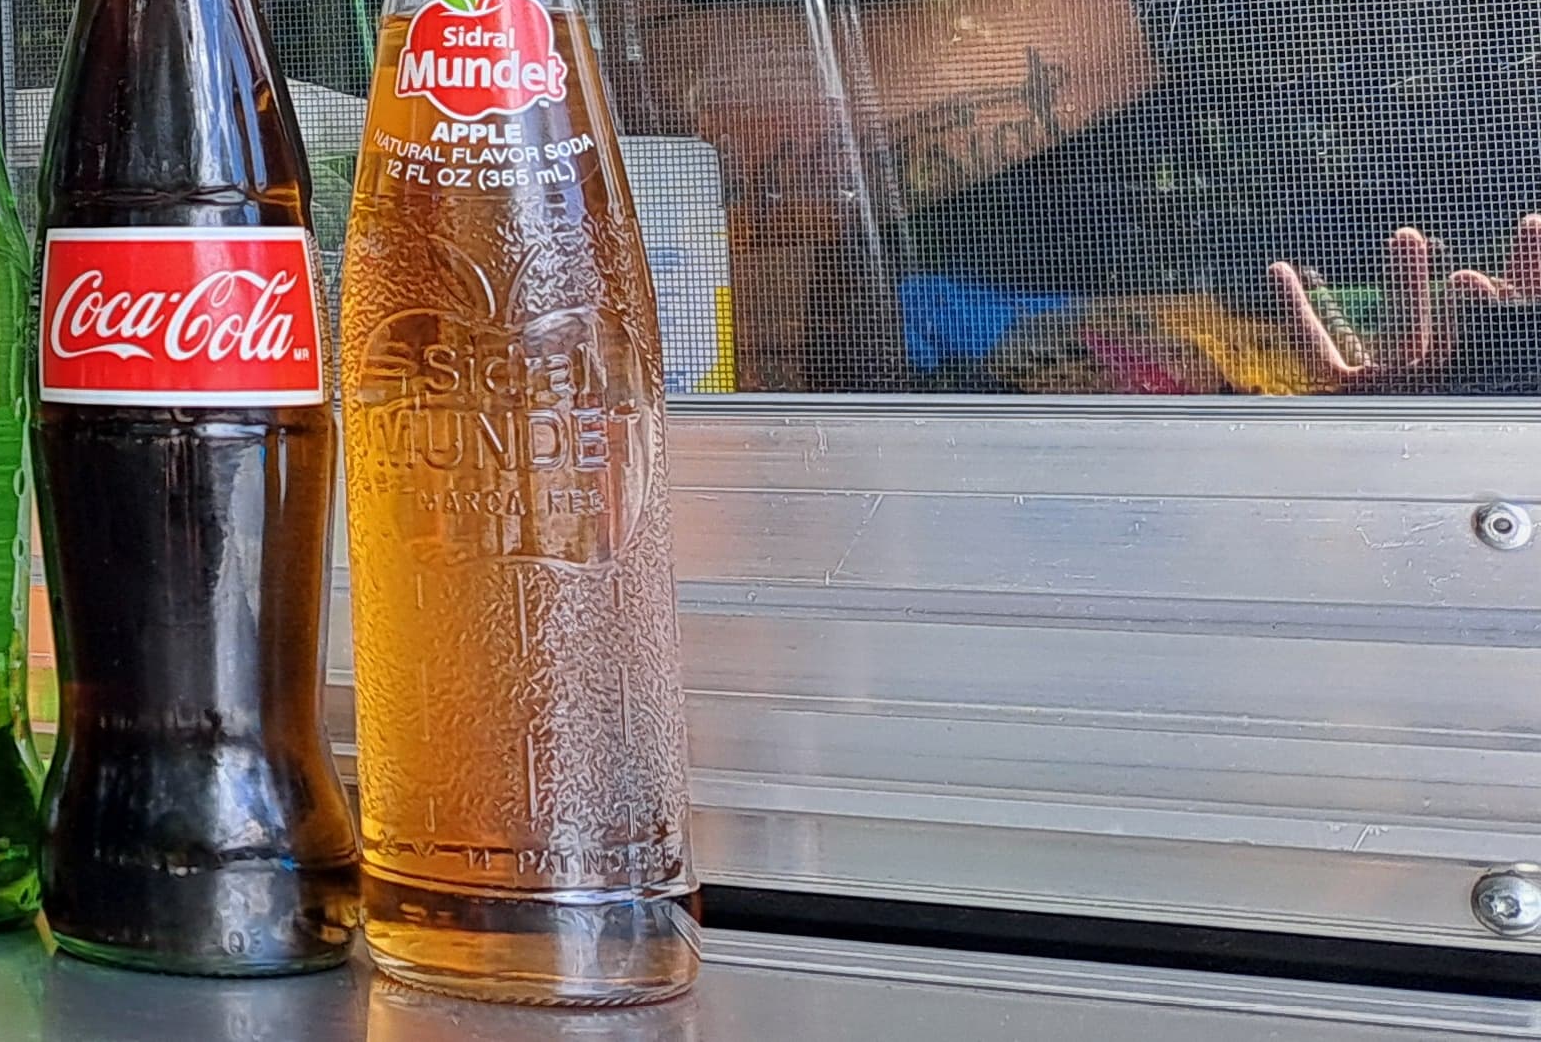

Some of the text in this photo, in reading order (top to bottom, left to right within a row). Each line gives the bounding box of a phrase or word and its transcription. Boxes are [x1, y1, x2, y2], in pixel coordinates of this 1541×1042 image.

[442, 26, 515, 49] Sidral
[400, 49, 561, 94] Mundet
[373, 129, 594, 165] NATURAL FLAVOR SODA
[431, 122, 522, 144] APPLE
[386, 159, 576, 190] 12 FL OZ (355 mL)
[50, 269, 298, 362] Coca-Cola
